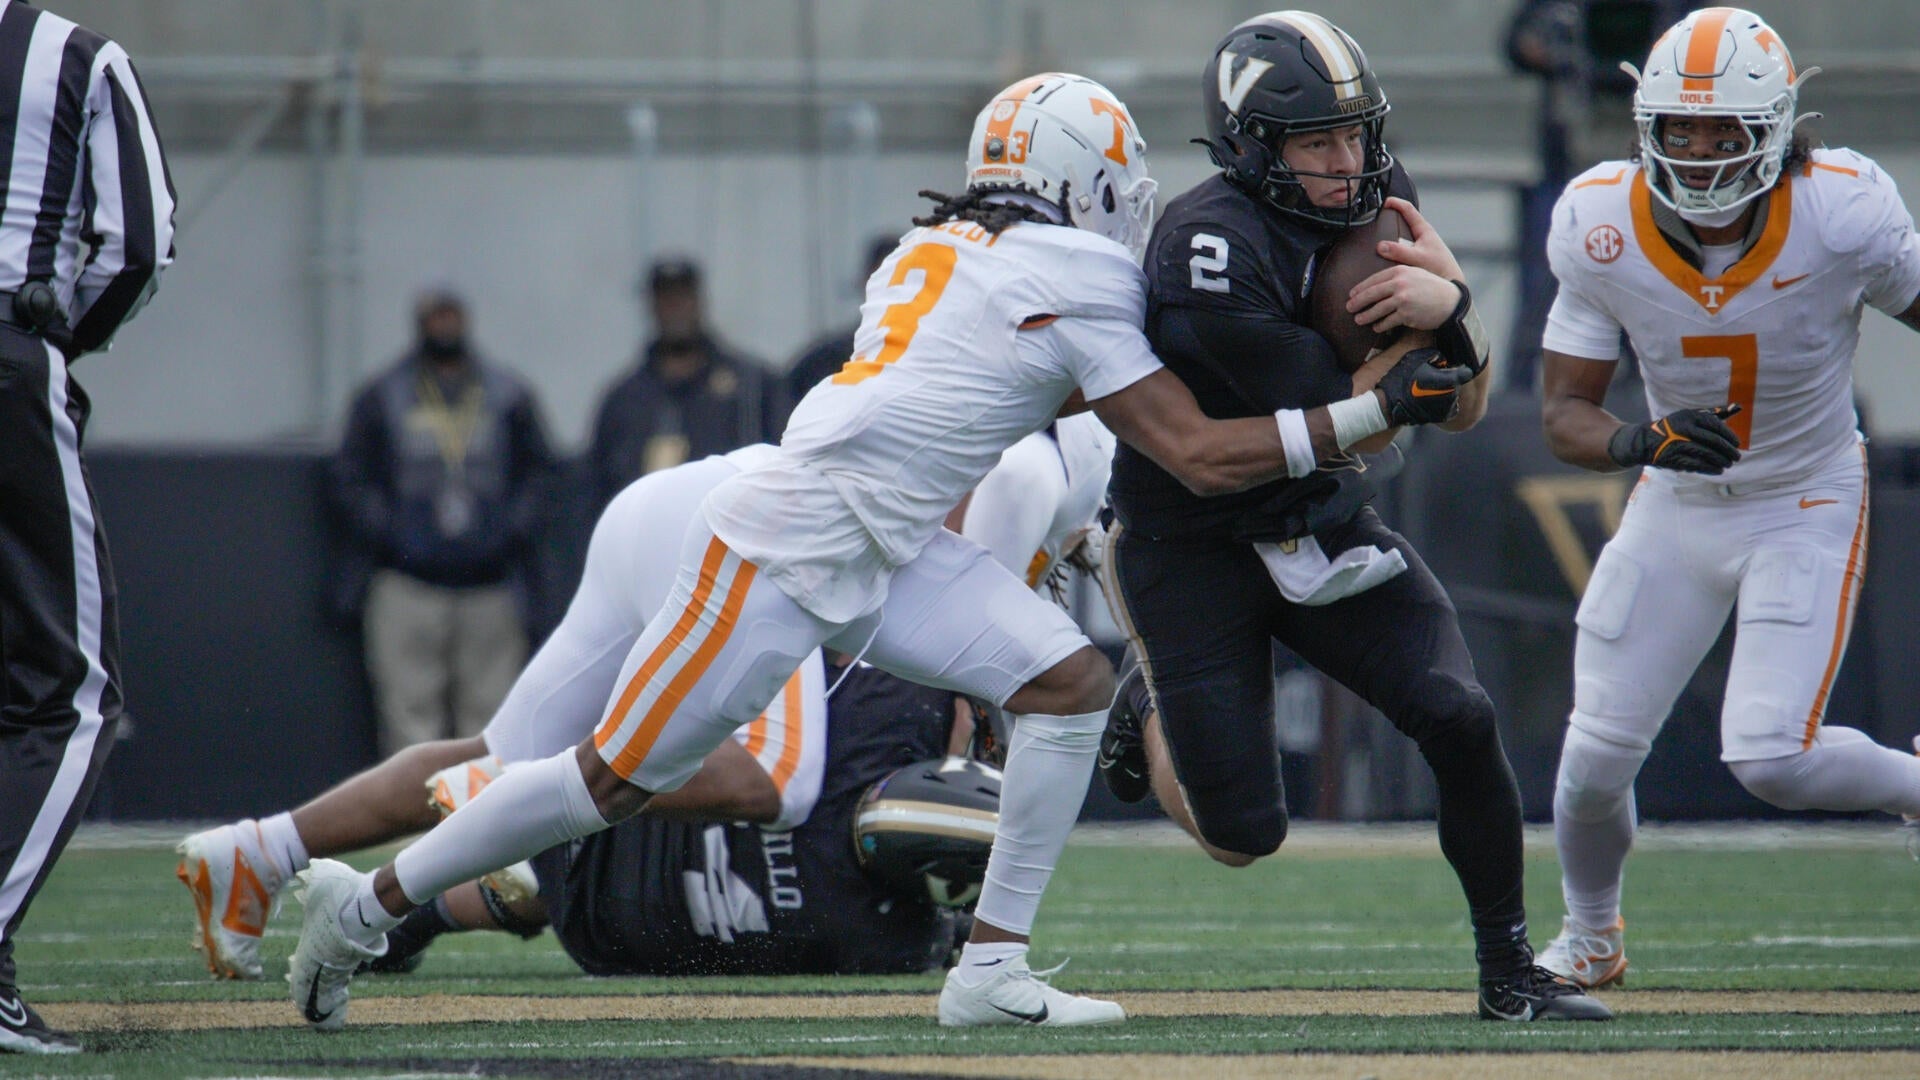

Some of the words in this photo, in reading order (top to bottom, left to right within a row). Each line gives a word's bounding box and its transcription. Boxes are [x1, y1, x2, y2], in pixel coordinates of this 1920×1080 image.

[1680, 93, 1714, 105] VOLS
[1009, 131, 1030, 164] 3
[1088, 97, 1128, 168] T
[1189, 233, 1230, 293] 2
[1586, 226, 1622, 262] SEC
[831, 242, 958, 385] 3
[1701, 285, 1724, 307] T
[1680, 333, 1758, 450] 7
[761, 830, 802, 909] ILLO
